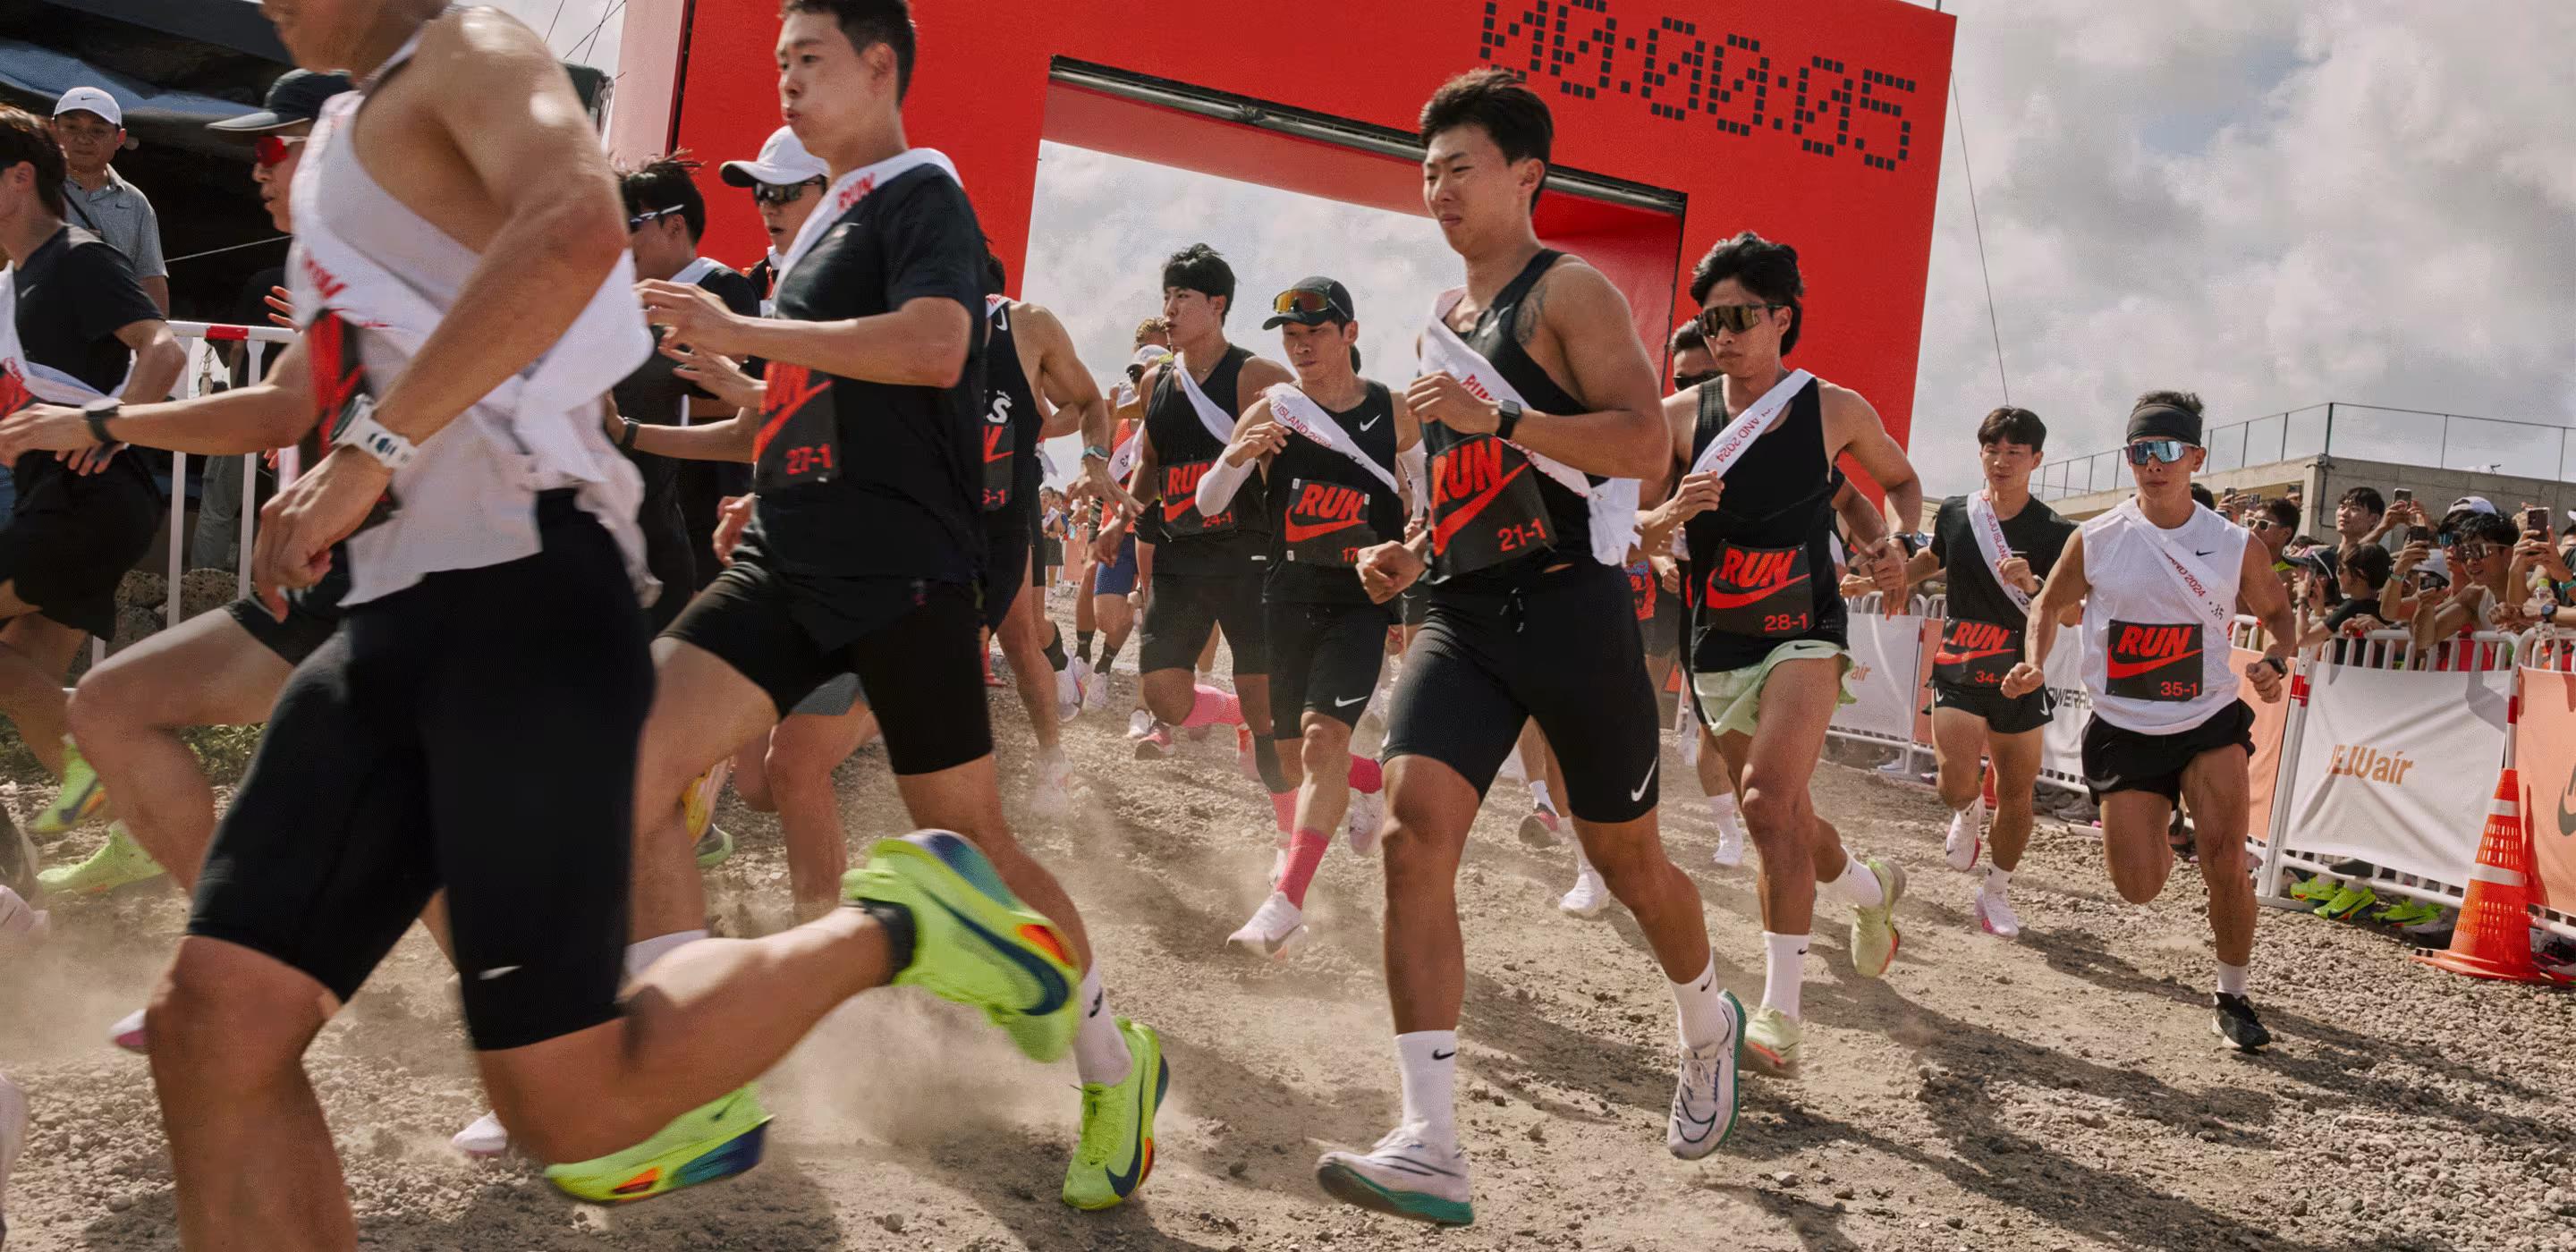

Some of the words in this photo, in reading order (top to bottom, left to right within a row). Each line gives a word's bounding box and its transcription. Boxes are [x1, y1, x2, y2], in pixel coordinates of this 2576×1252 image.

[786, 443, 832, 475] 27-1
[1716, 437, 1741, 463] 2024
[1294, 484, 1365, 520] RUN
[1497, 518, 1546, 552] 21-1
[1719, 546, 1797, 588] RUN
[2184, 573, 2207, 597] 2024
[1764, 612, 1808, 632] 28-1
[1953, 622, 2010, 651] RUN
[2117, 625, 2194, 657] RUN
[1974, 671, 2005, 684] 34-
[2160, 681, 2199, 697] 35-1
